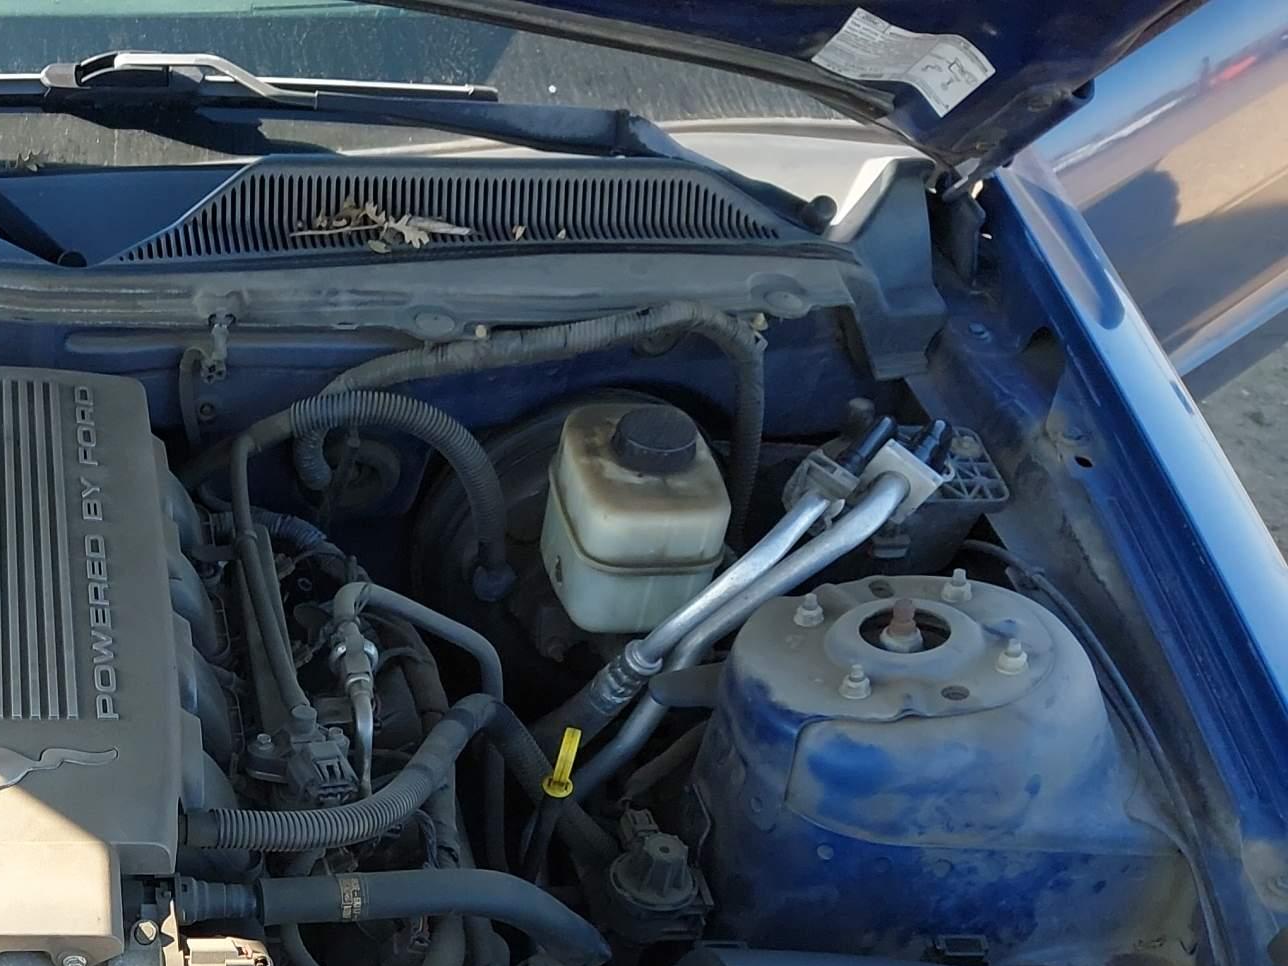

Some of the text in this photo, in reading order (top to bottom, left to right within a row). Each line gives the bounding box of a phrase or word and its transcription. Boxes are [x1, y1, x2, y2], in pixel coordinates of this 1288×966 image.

[74, 386, 119, 720] POWERED BY FORD
